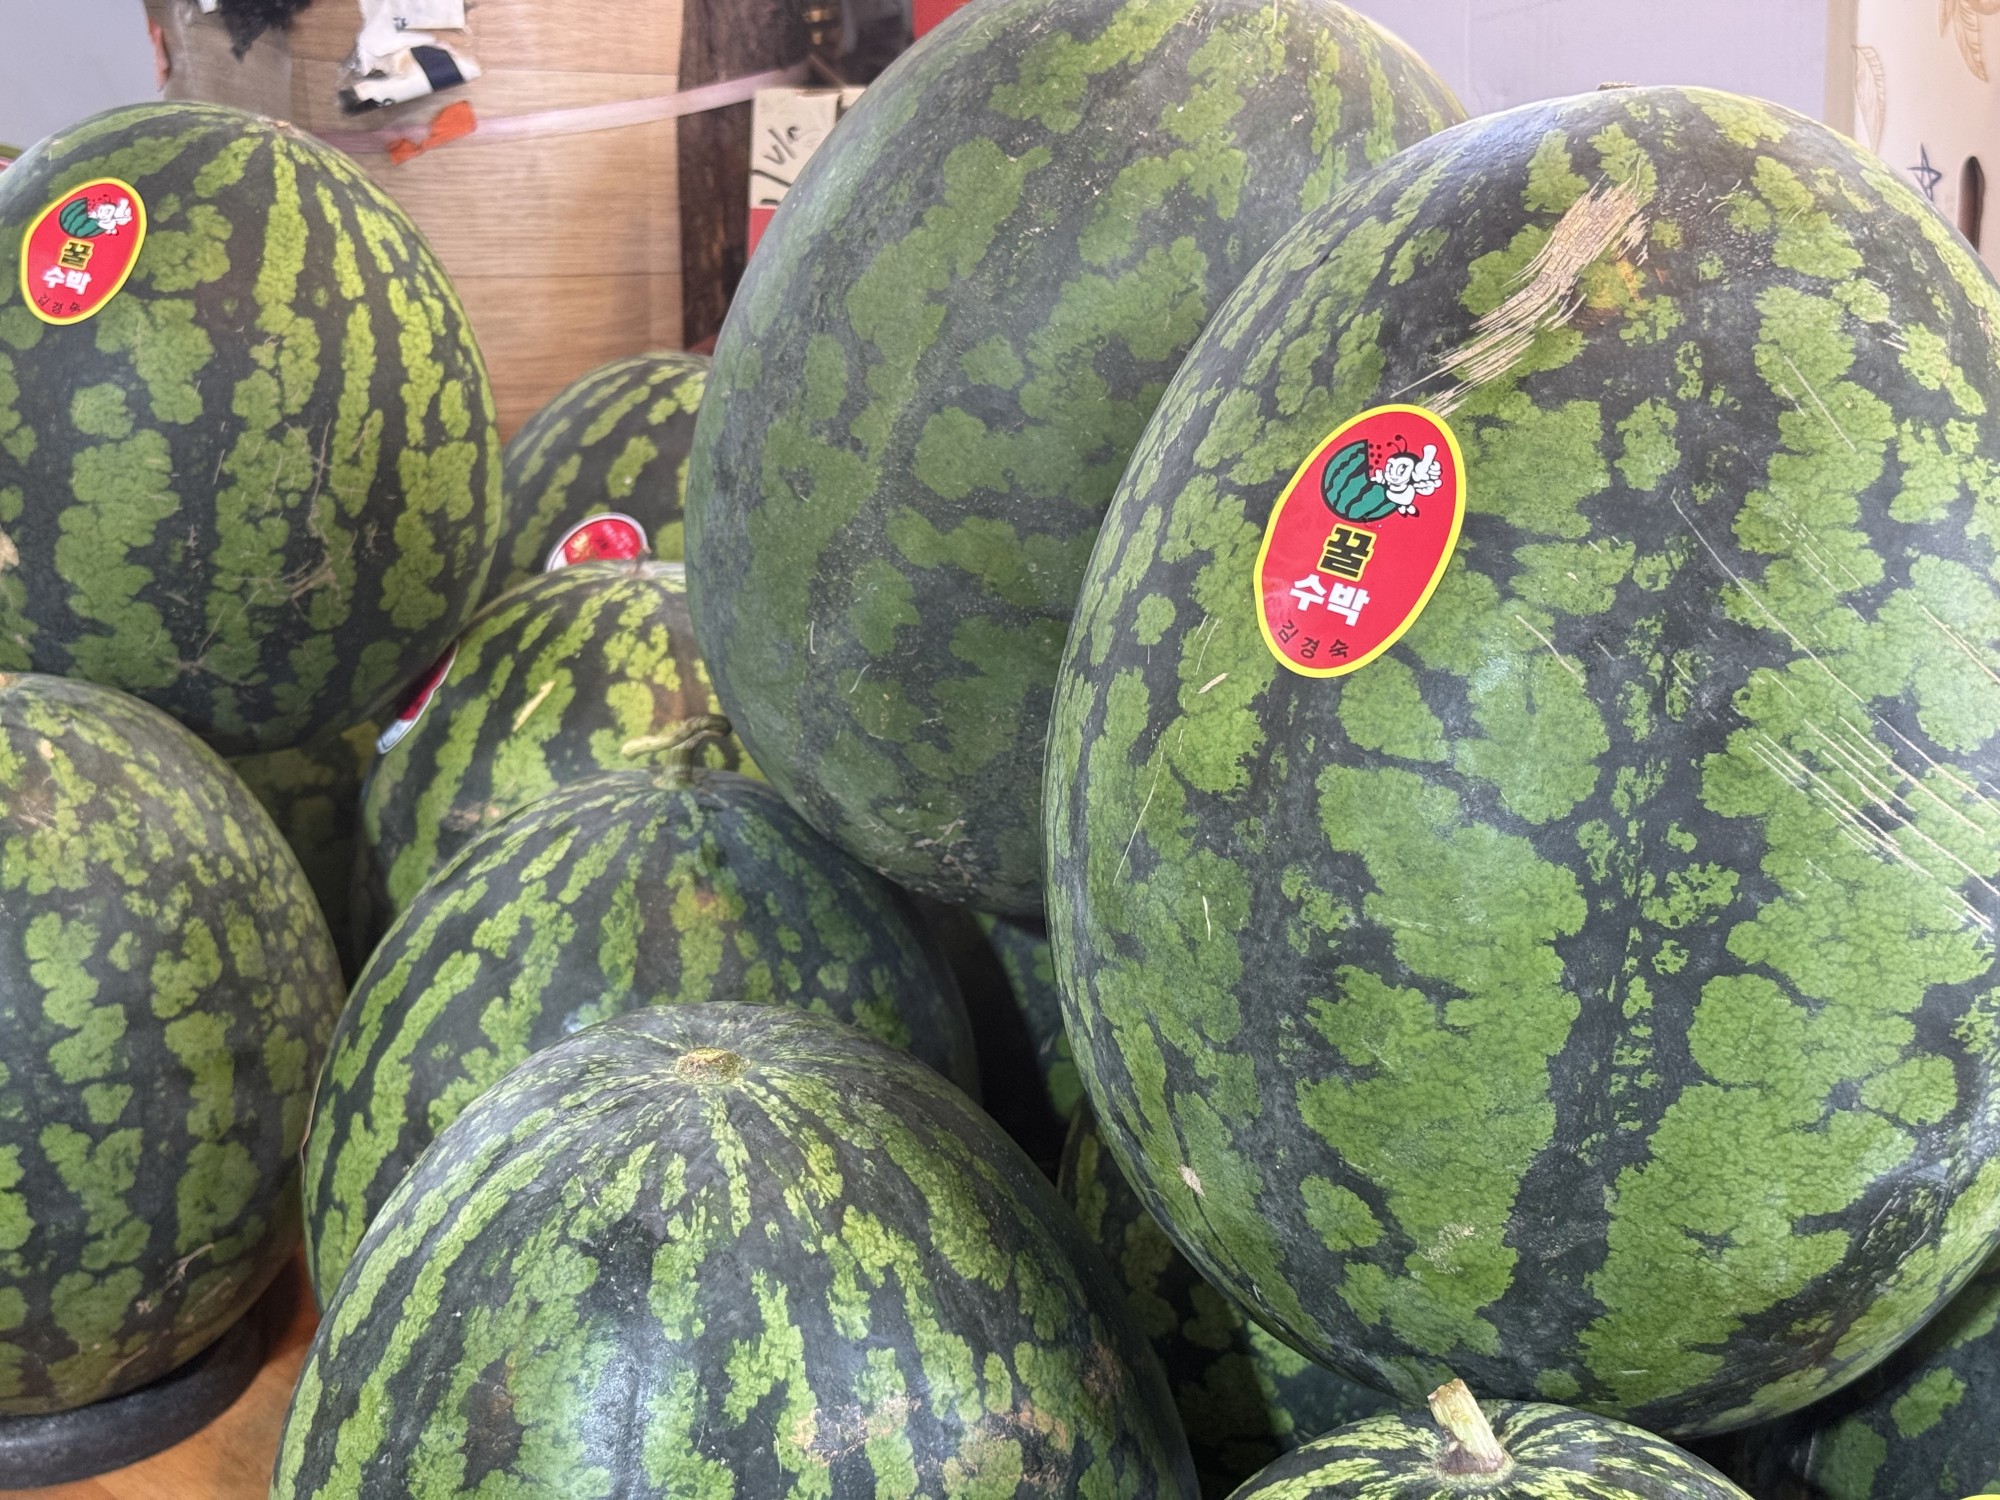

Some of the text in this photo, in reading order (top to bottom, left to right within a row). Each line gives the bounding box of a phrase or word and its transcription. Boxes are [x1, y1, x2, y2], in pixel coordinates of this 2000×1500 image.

[59, 238, 94, 270] 꿀
[43, 265, 92, 295] 수박
[1317, 523, 1377, 582] 꿀
[1290, 574, 1370, 626] 수박
